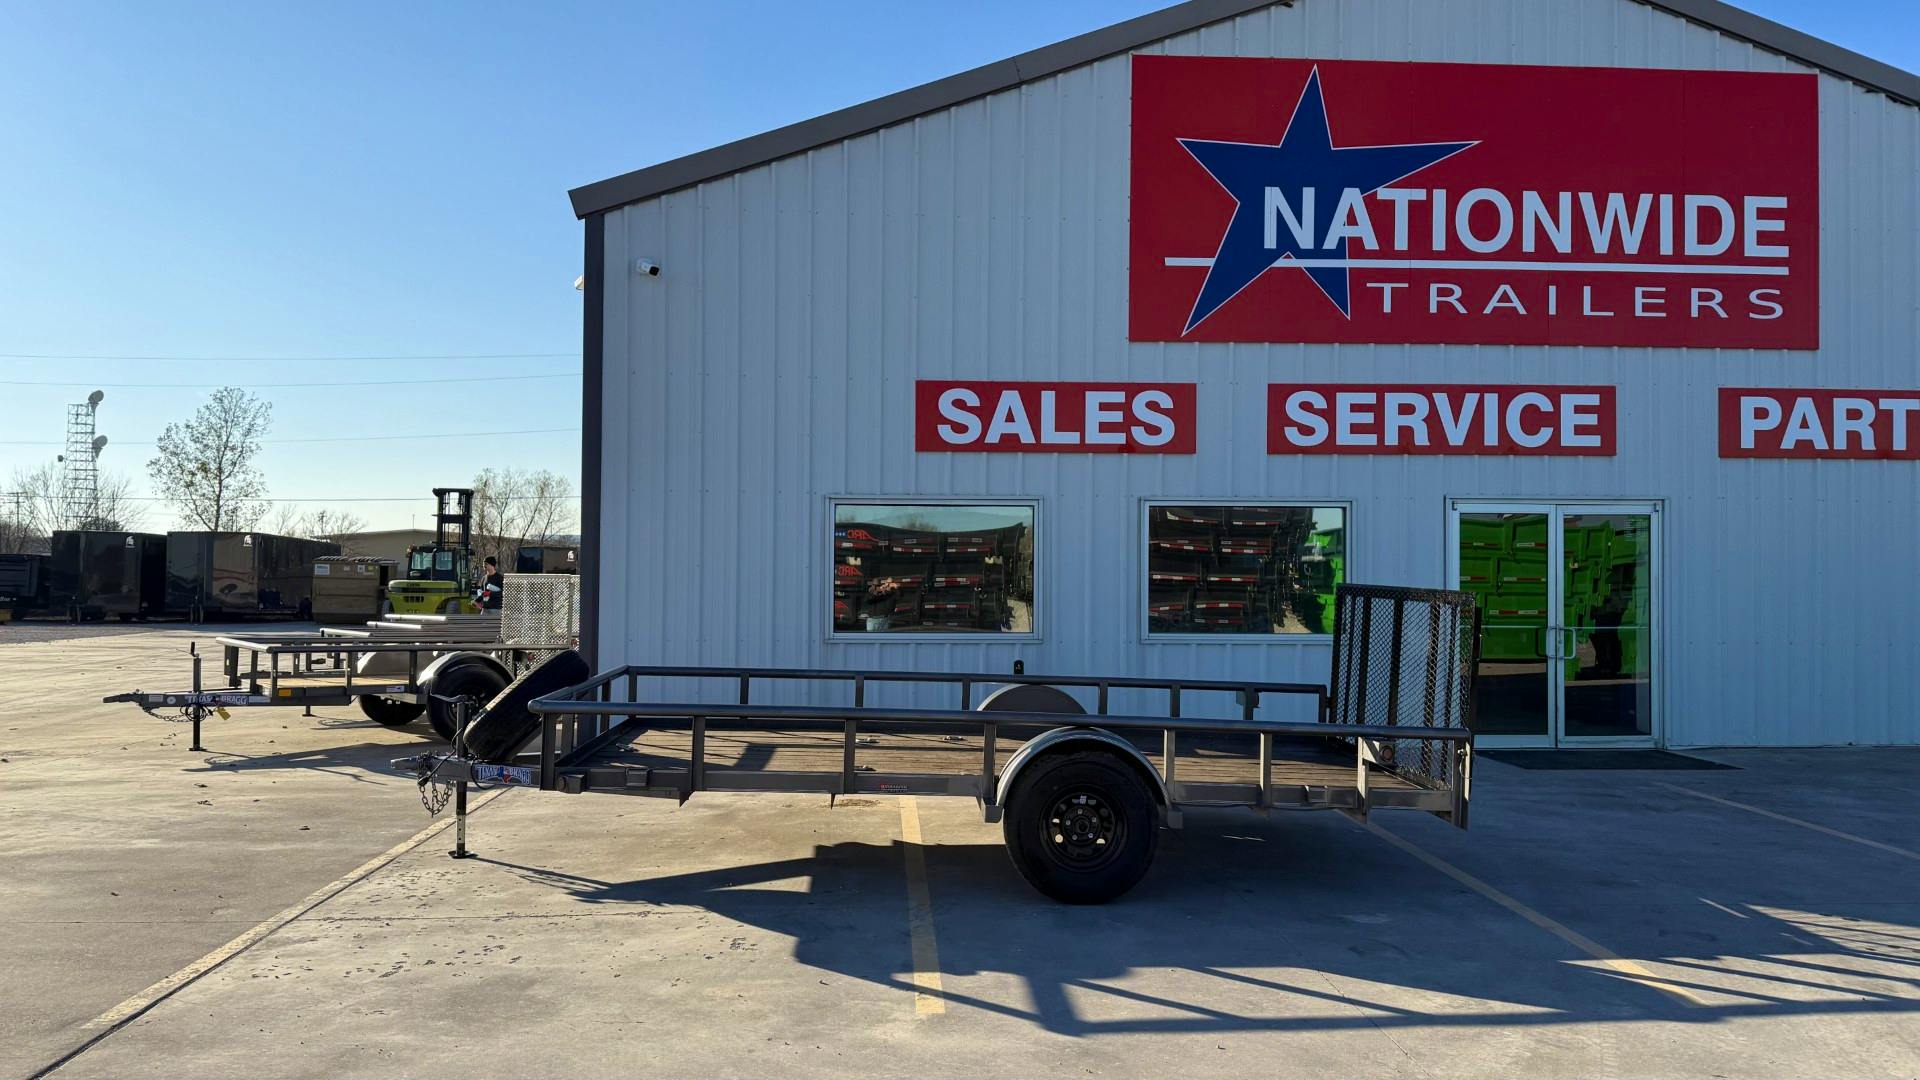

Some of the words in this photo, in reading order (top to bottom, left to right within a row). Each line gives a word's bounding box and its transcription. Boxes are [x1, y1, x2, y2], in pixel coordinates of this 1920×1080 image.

[1263, 186, 1790, 258] NATIONWIDE
[1366, 282, 1783, 320] TRAILERS
[937, 388, 1175, 446] SALES
[1284, 390, 1601, 448] SERVICE
[1740, 396, 1920, 451] PART
[509, 767, 531, 785] BRAGG
